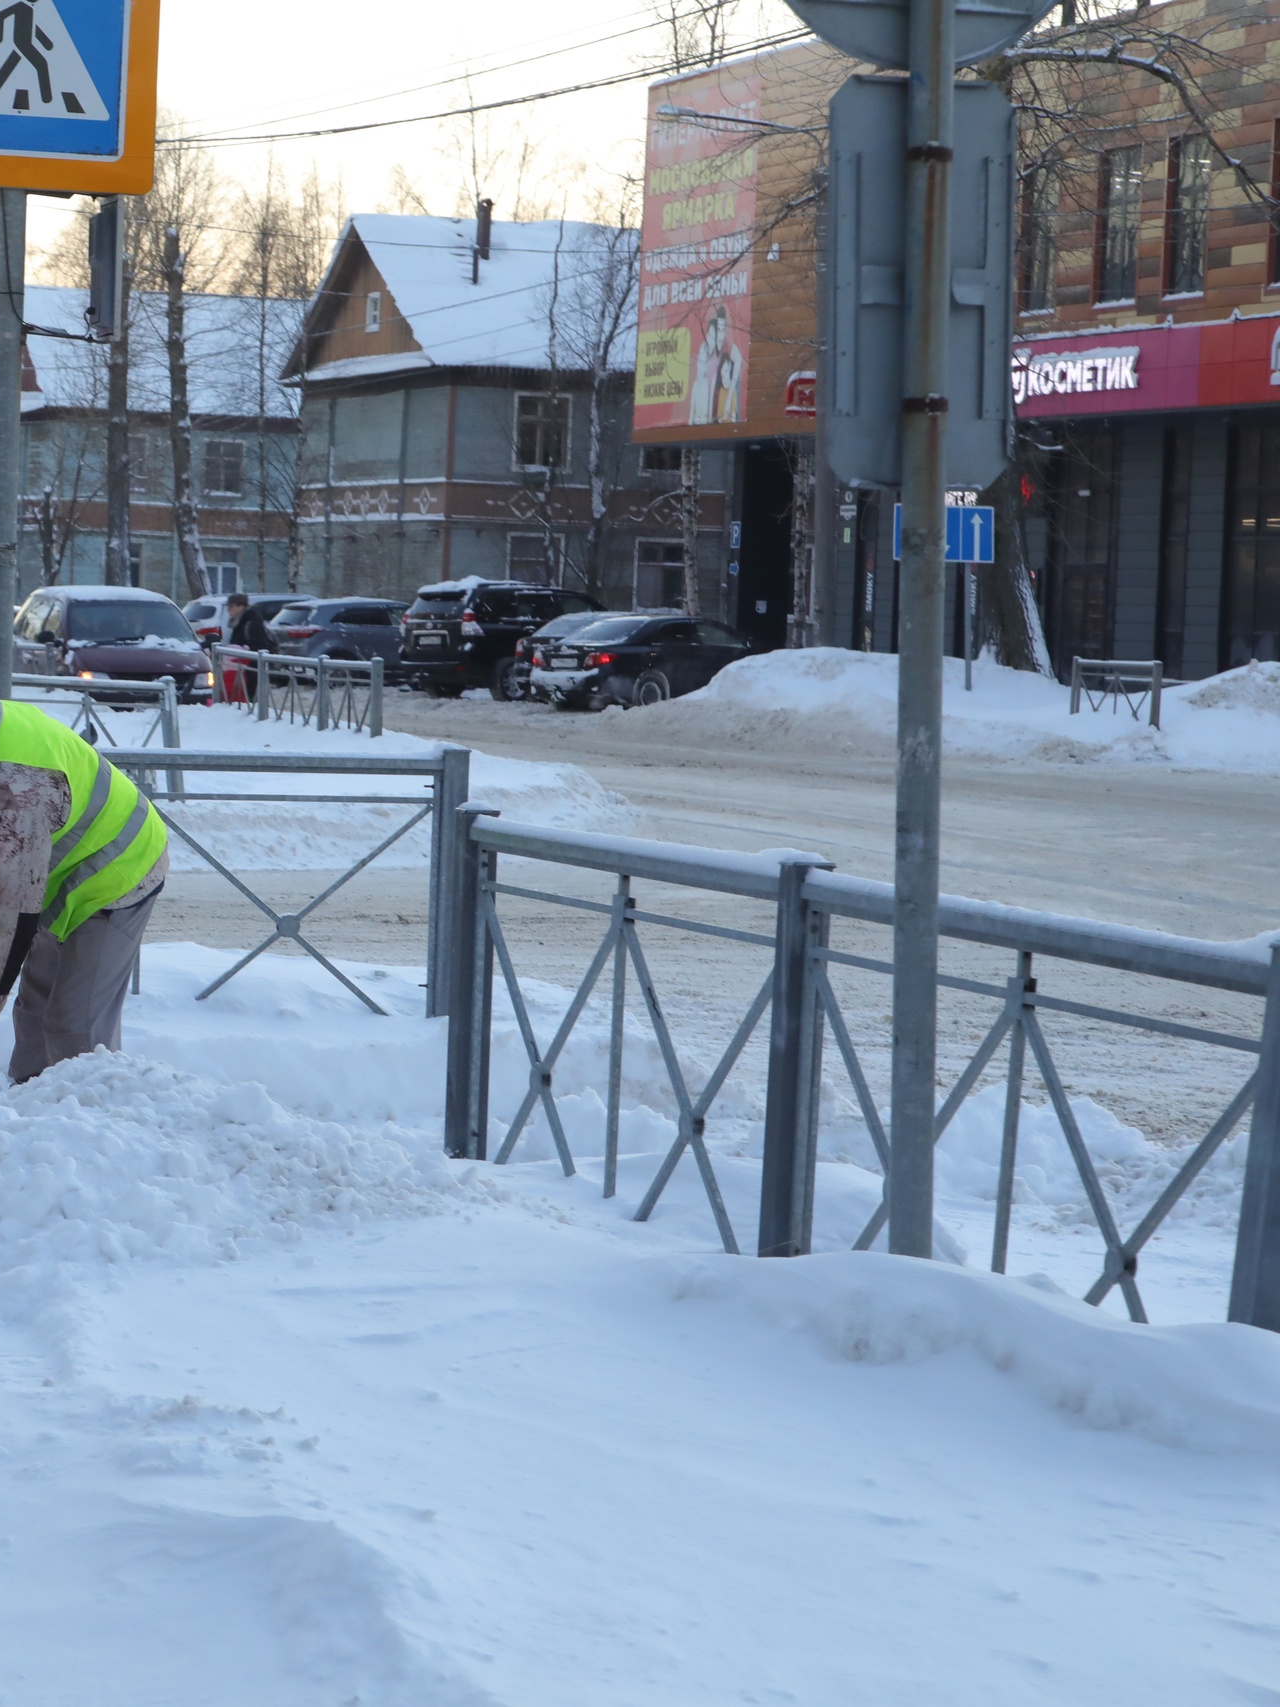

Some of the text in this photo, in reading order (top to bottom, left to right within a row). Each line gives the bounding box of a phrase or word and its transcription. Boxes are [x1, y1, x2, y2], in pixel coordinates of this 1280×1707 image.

[649, 148, 754, 196] МОСКОВСКАЯ
[662, 190, 735, 231] ЯРМАРКА
[645, 243, 696, 274] ОДЕЖДА
[710, 234, 750, 262] ОБУВЬ
[643, 270, 748, 311] ДЛЯ ВСЕЙ СЕМЬИ
[1027, 355, 1135, 396] КОСМЕТИК
[732, 525, 739, 545] P
[865, 571, 874, 612] SMOKY
